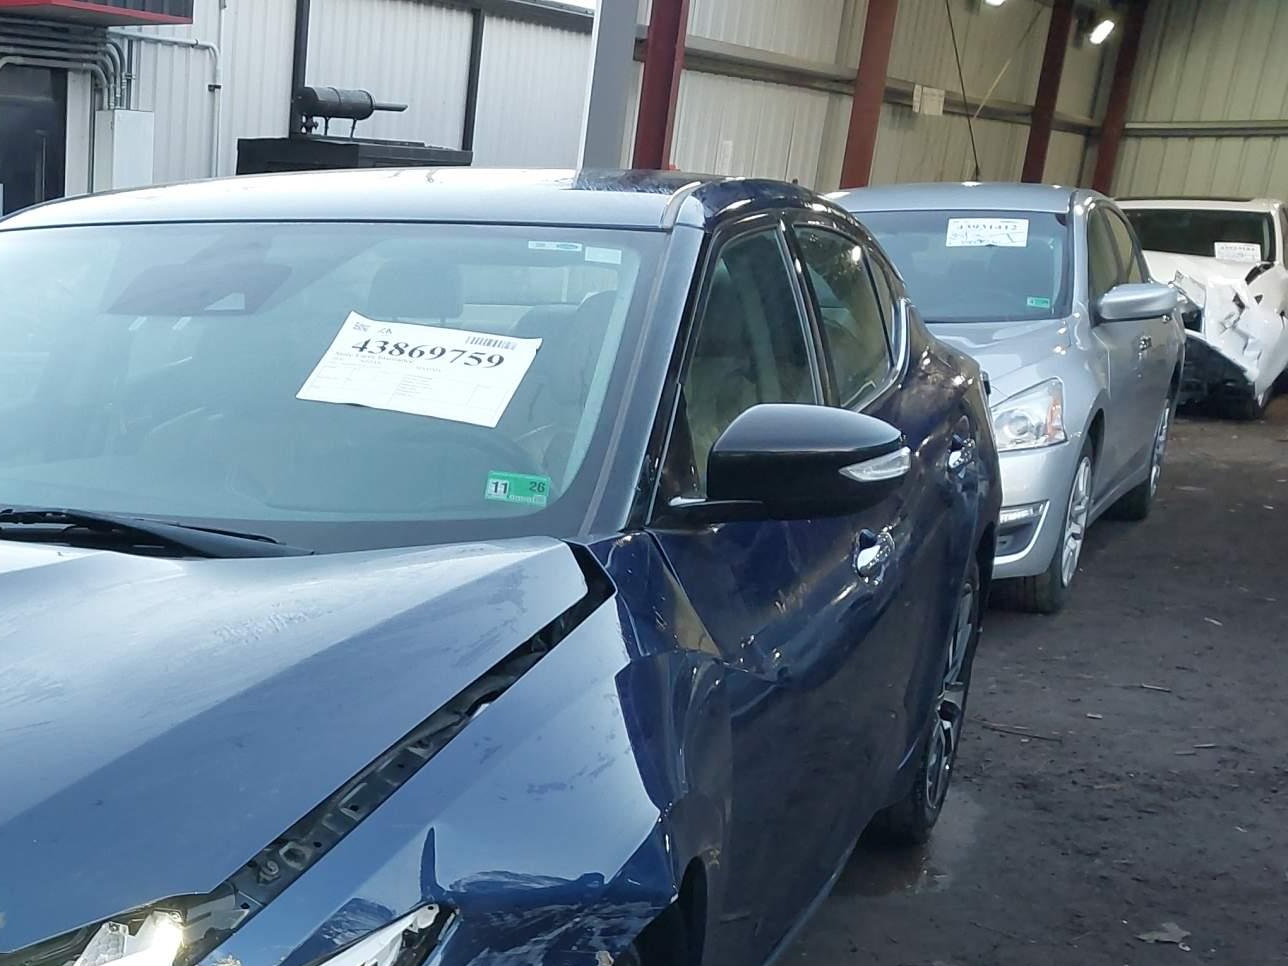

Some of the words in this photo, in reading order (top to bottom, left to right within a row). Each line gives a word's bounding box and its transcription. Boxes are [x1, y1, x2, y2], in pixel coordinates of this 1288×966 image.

[351, 338, 505, 369] 43869759
[492, 481, 509, 495] 11
[528, 481, 546, 493] 26
